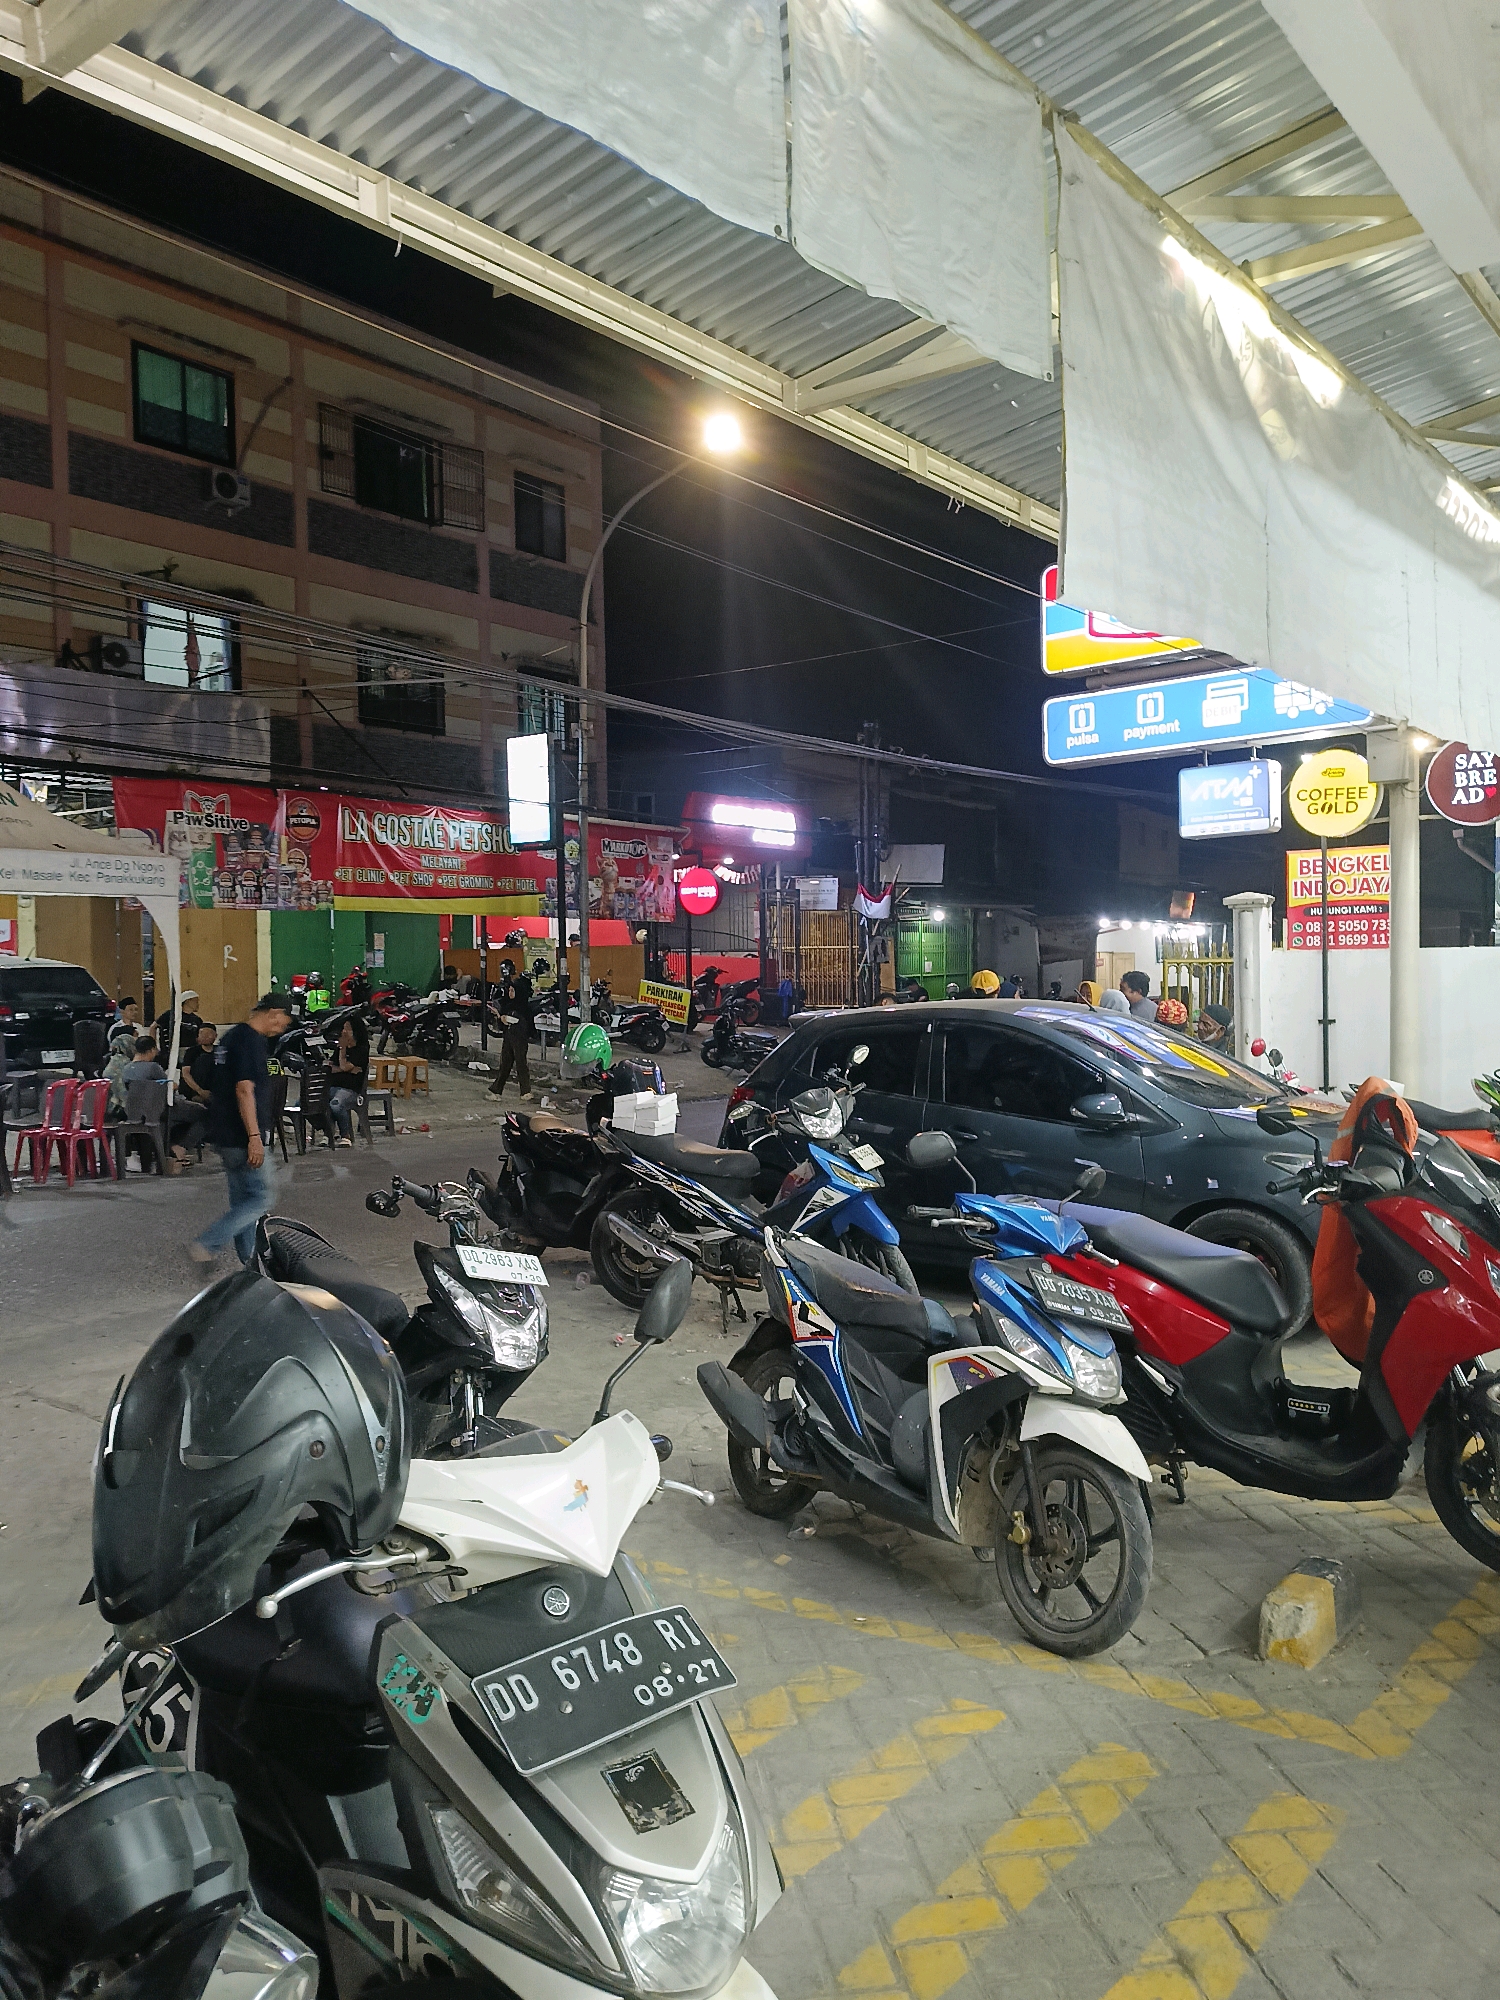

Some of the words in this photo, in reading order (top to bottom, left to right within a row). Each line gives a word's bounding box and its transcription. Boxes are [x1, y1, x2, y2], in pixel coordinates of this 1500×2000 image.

[1066, 732, 1099, 749] pulsa
[1123, 719, 1181, 742] payment
[1455, 751, 1496, 770] SAY
[1454, 769, 1498, 788] BRE
[1296, 786, 1369, 802] COFFEE
[1451, 787, 1485, 805] AD
[1307, 800, 1359, 815] GOLD
[173, 811, 250, 831] PawSitive
[343, 807, 370, 843] LA
[373, 812, 446, 849] COSTAE
[448, 820, 522, 855] PETSHO
[114, 859, 130, 873] Dg
[132, 860, 165, 874] Ngoyo
[1299, 854, 1390, 876] BENGKEL
[356, 869, 385, 884] CLINIC
[412, 872, 434, 886] SHOP
[515, 878, 539, 892] HOTEL
[1310, 907, 1352, 916] HUUNGI
[1306, 920, 1336, 933] 082
[1338, 920, 1369, 932] 5050
[1306, 935, 1336, 948] 081
[1338, 934, 1369, 946] 9699
[646, 985, 684, 1003] PARKIRAN
[482, 1251, 513, 1268] 2963
[980, 1272, 1005, 1297] YAMAHA
[1057, 1281, 1091, 1302] 2035
[483, 1673, 540, 1722] DD
[550, 1632, 643, 1691] 6748
[653, 1614, 701, 1652] RI
